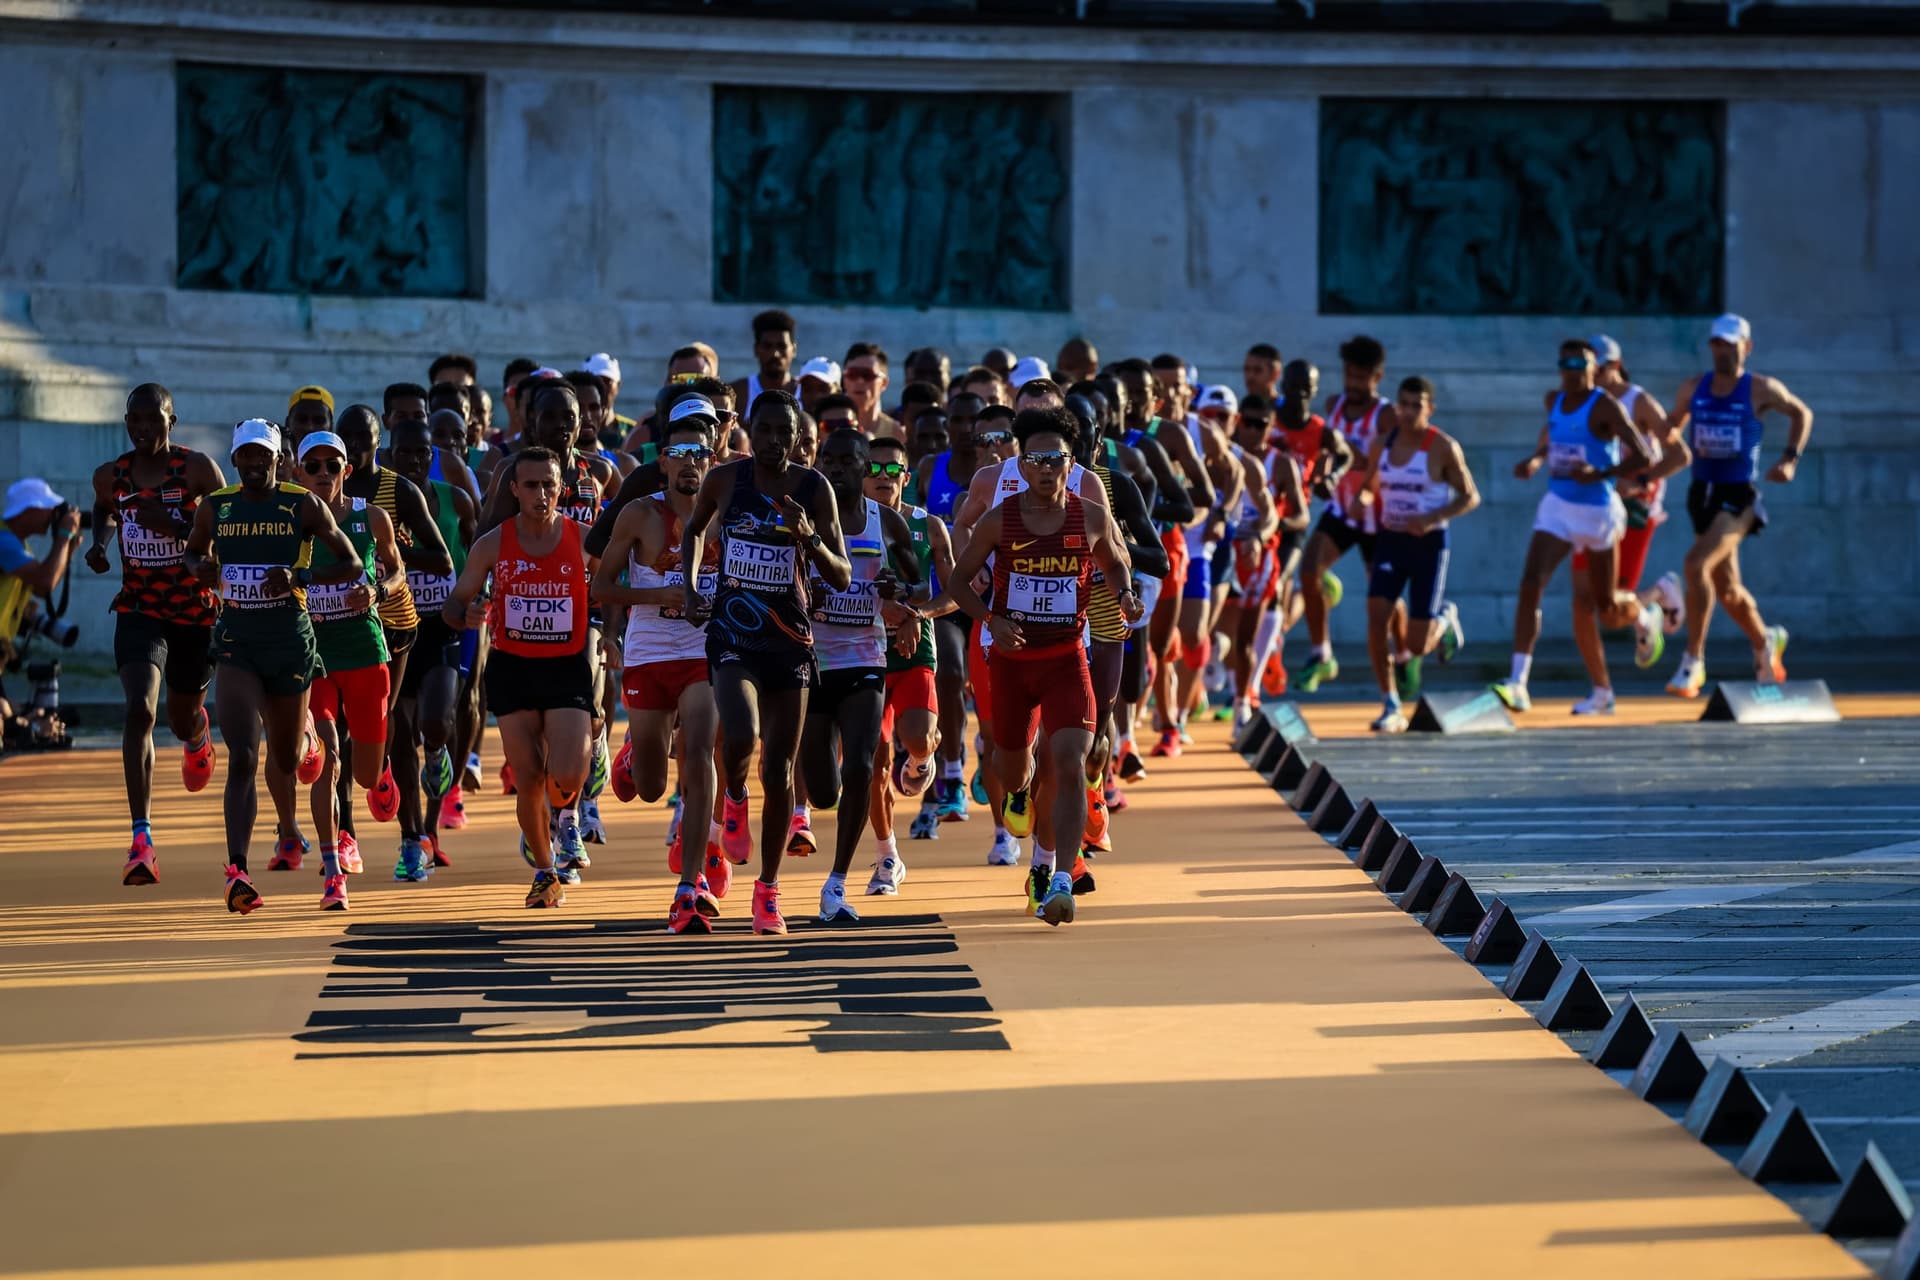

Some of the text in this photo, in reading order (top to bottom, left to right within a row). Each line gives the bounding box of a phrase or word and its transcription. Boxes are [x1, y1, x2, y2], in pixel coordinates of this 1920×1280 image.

[217, 522, 294, 537] SOUTH AFRICA
[744, 544, 792, 563] TDK
[729, 558, 789, 581] MUHITIRA
[1013, 556, 1079, 573] CHINA
[413, 585, 450, 601] POFU
[511, 580, 570, 595] TÜRKİYE
[846, 581, 875, 595] DK
[1028, 578, 1073, 594] TDK
[523, 599, 567, 613] TDK
[823, 594, 874, 614] KIZIMANA
[1033, 597, 1053, 612] HE
[522, 616, 553, 630] CAN
